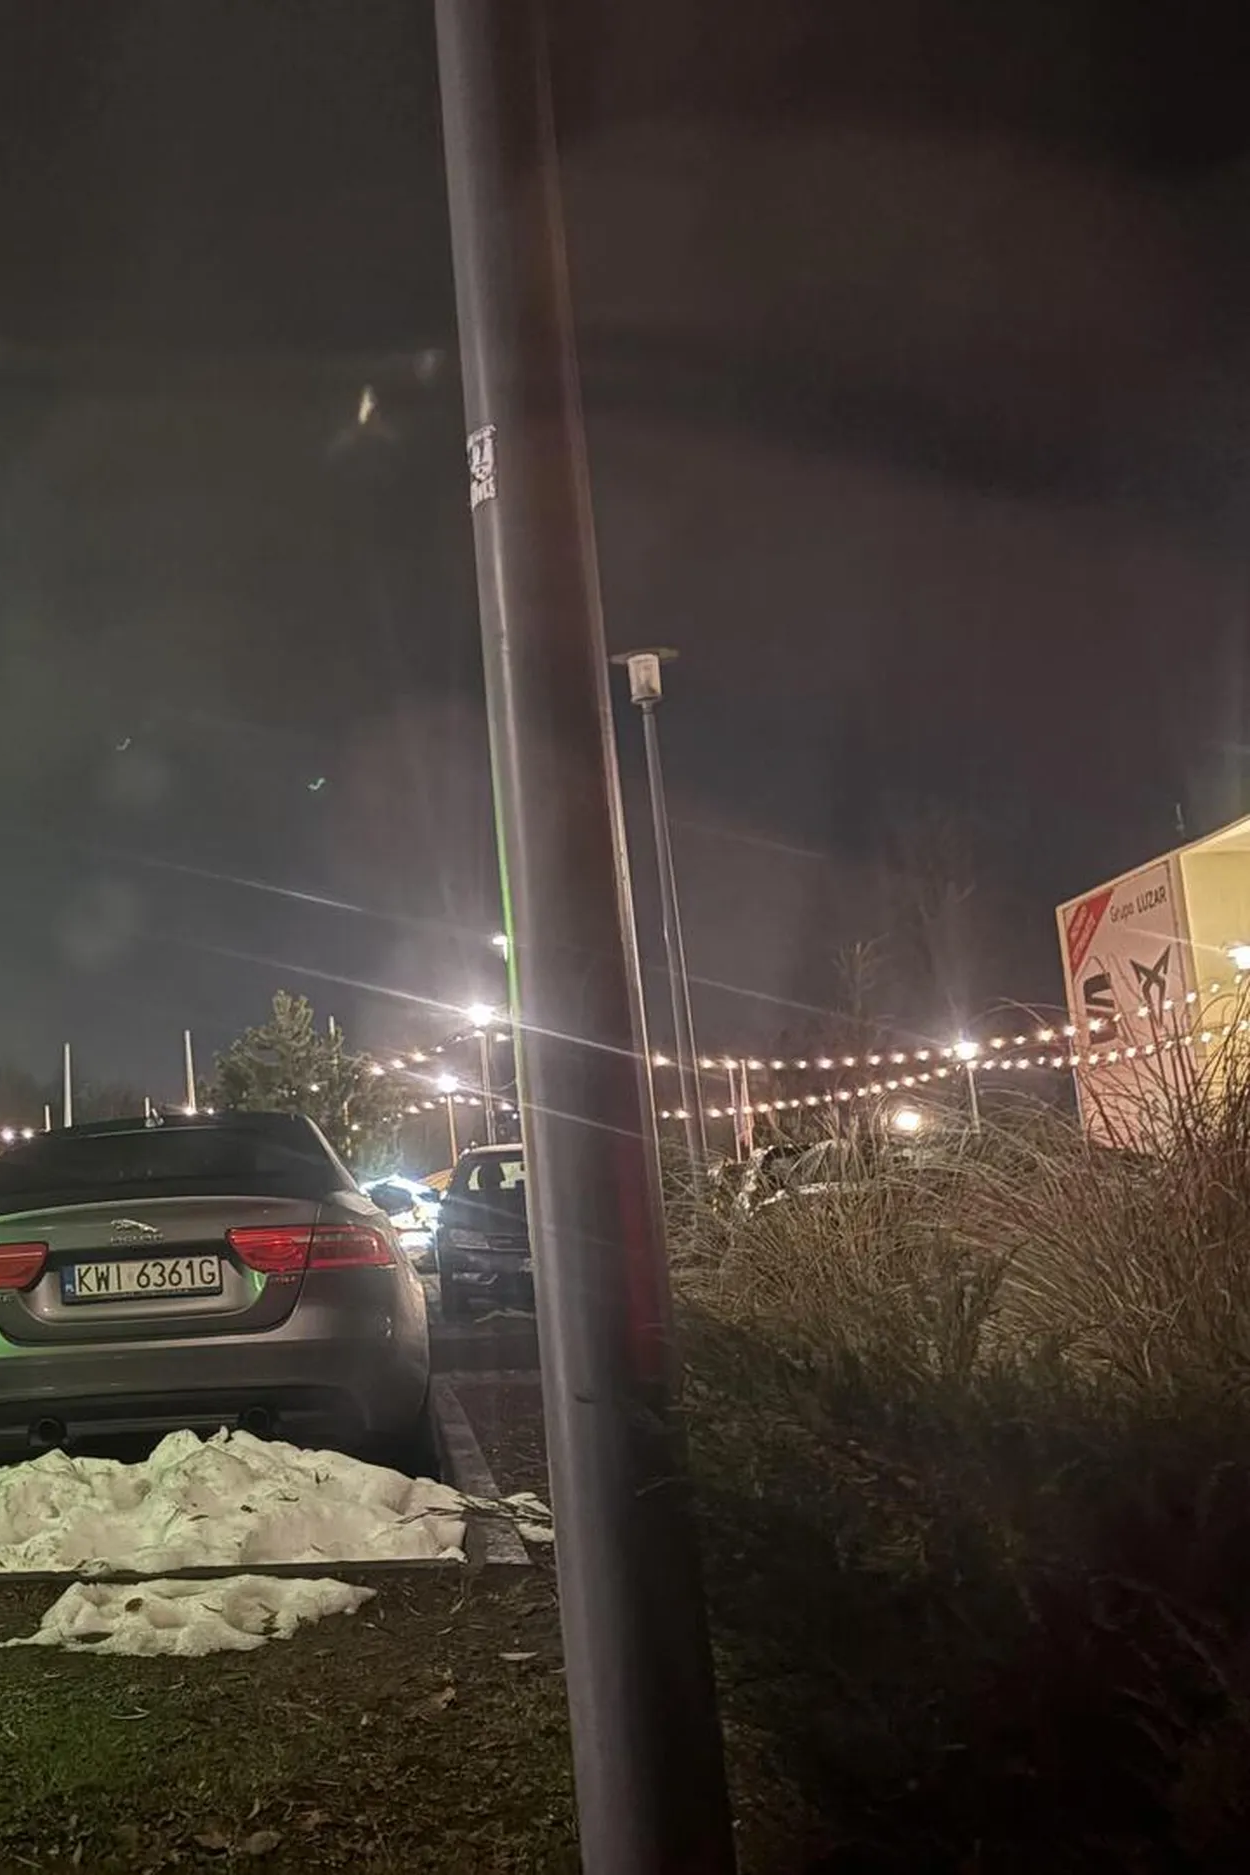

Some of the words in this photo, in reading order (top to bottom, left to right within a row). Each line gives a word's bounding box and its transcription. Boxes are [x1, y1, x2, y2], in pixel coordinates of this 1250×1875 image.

[1136, 885, 1168, 914] LUZAR
[77, 1265, 123, 1292] KWI
[136, 1259, 217, 1289] 6361G
